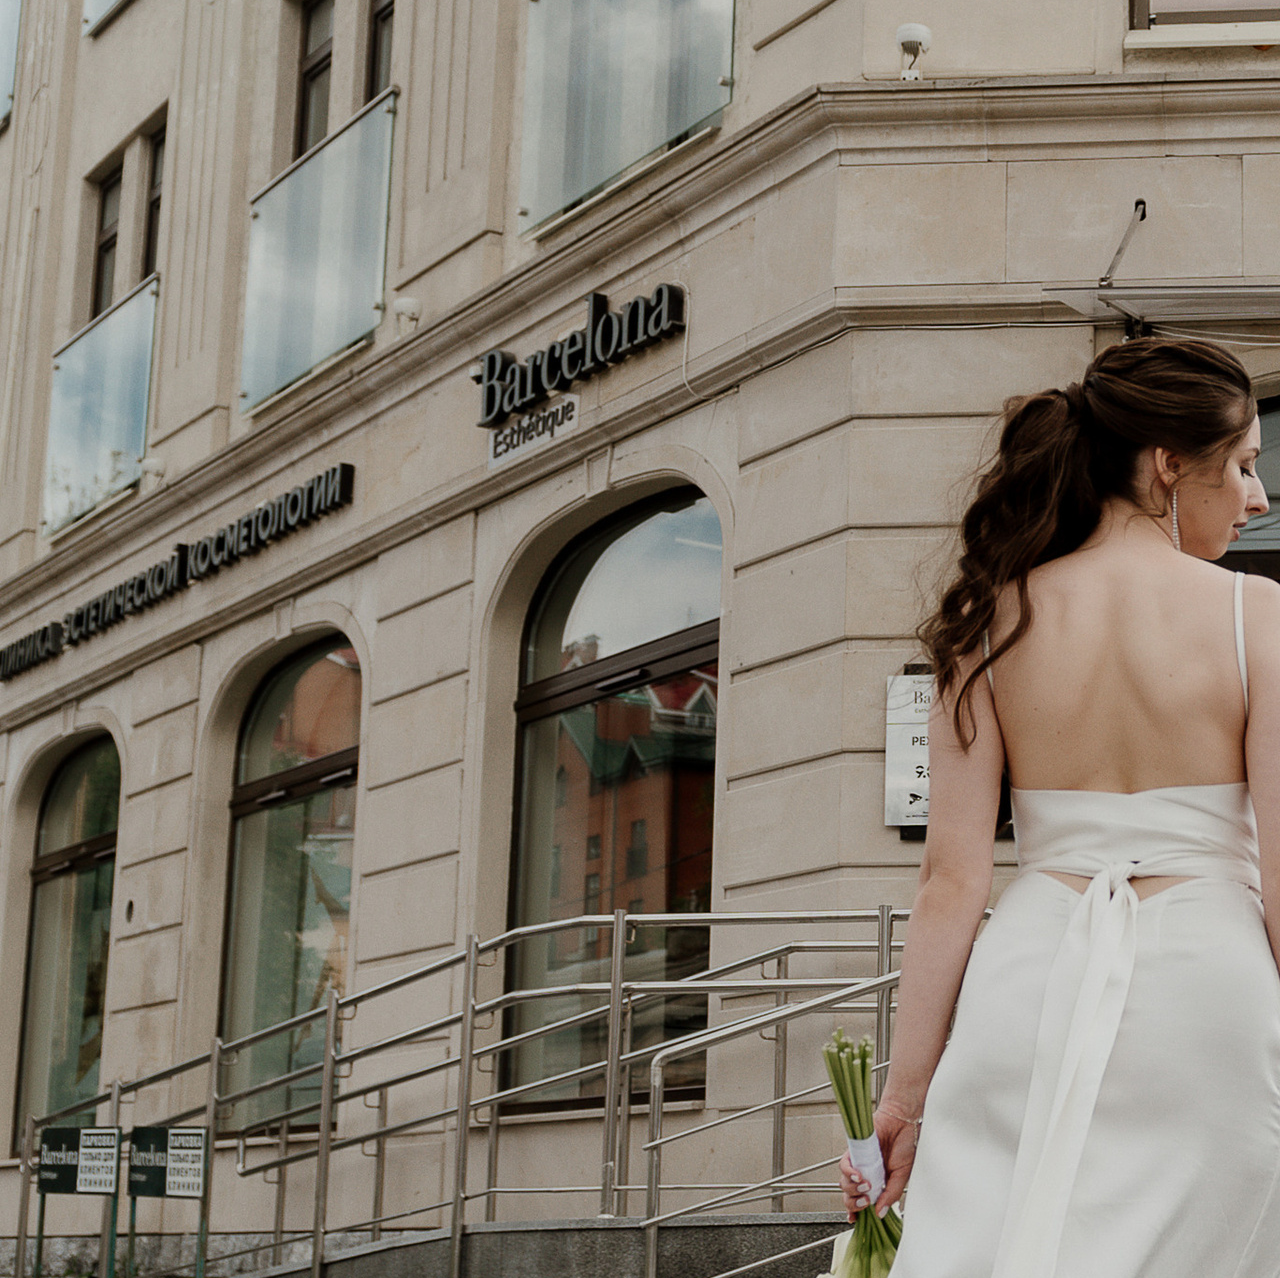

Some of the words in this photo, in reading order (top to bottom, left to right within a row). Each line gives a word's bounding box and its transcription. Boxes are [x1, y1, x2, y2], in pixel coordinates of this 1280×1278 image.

[478, 283, 686, 428] Barcelona
[62, 544, 188, 647] ЭСТЕТИЧЕСКОЙ
[186, 463, 355, 582] КОСМЕТОЛОГИИ
